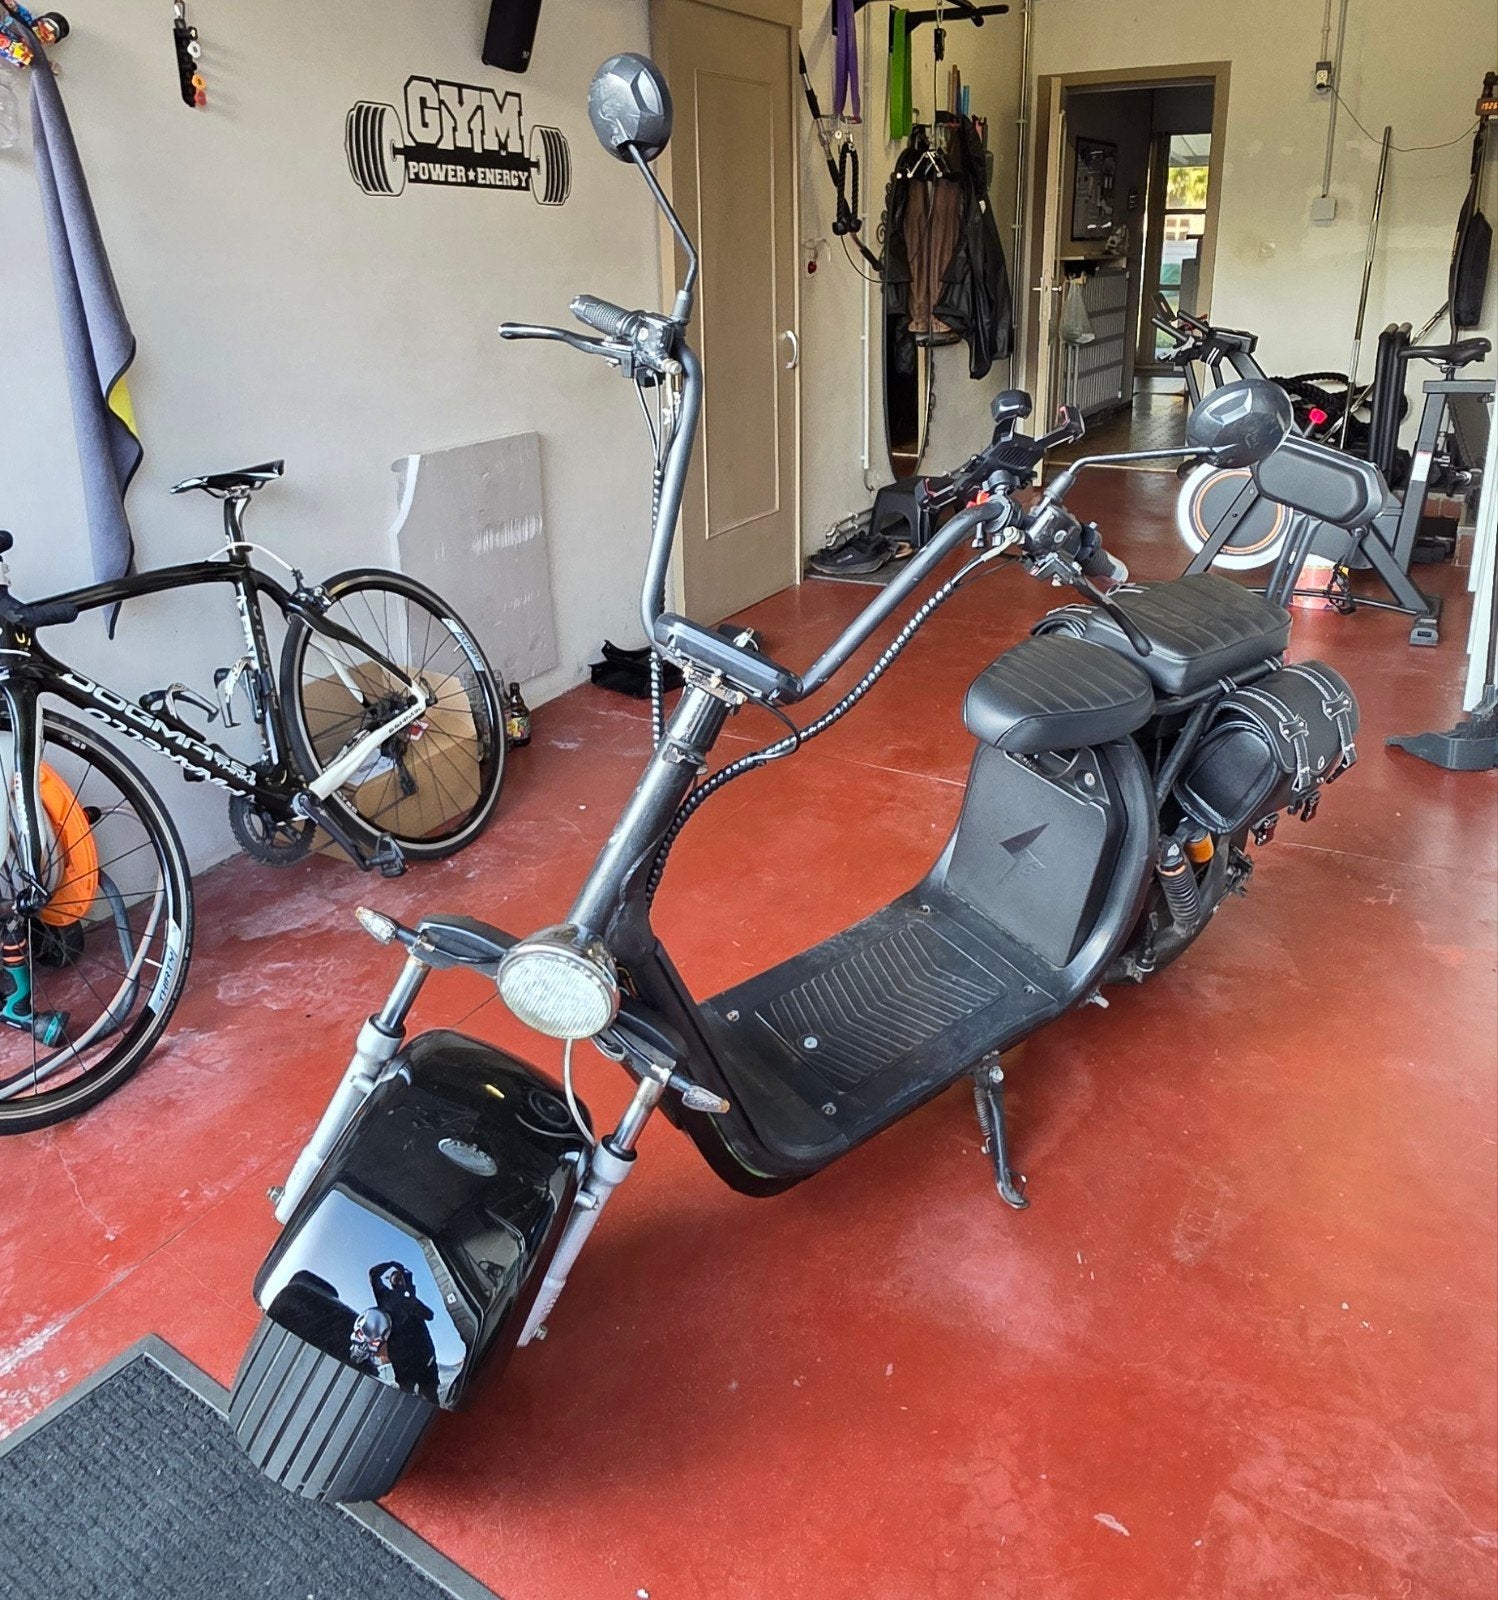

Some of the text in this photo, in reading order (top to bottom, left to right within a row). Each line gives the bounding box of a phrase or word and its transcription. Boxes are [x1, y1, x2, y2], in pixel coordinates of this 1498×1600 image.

[403, 75, 524, 154] GYM
[408, 161, 528, 187] POWER ENERGY
[58, 673, 215, 761] DOGMA
[158, 948, 177, 1002] THIRTY
